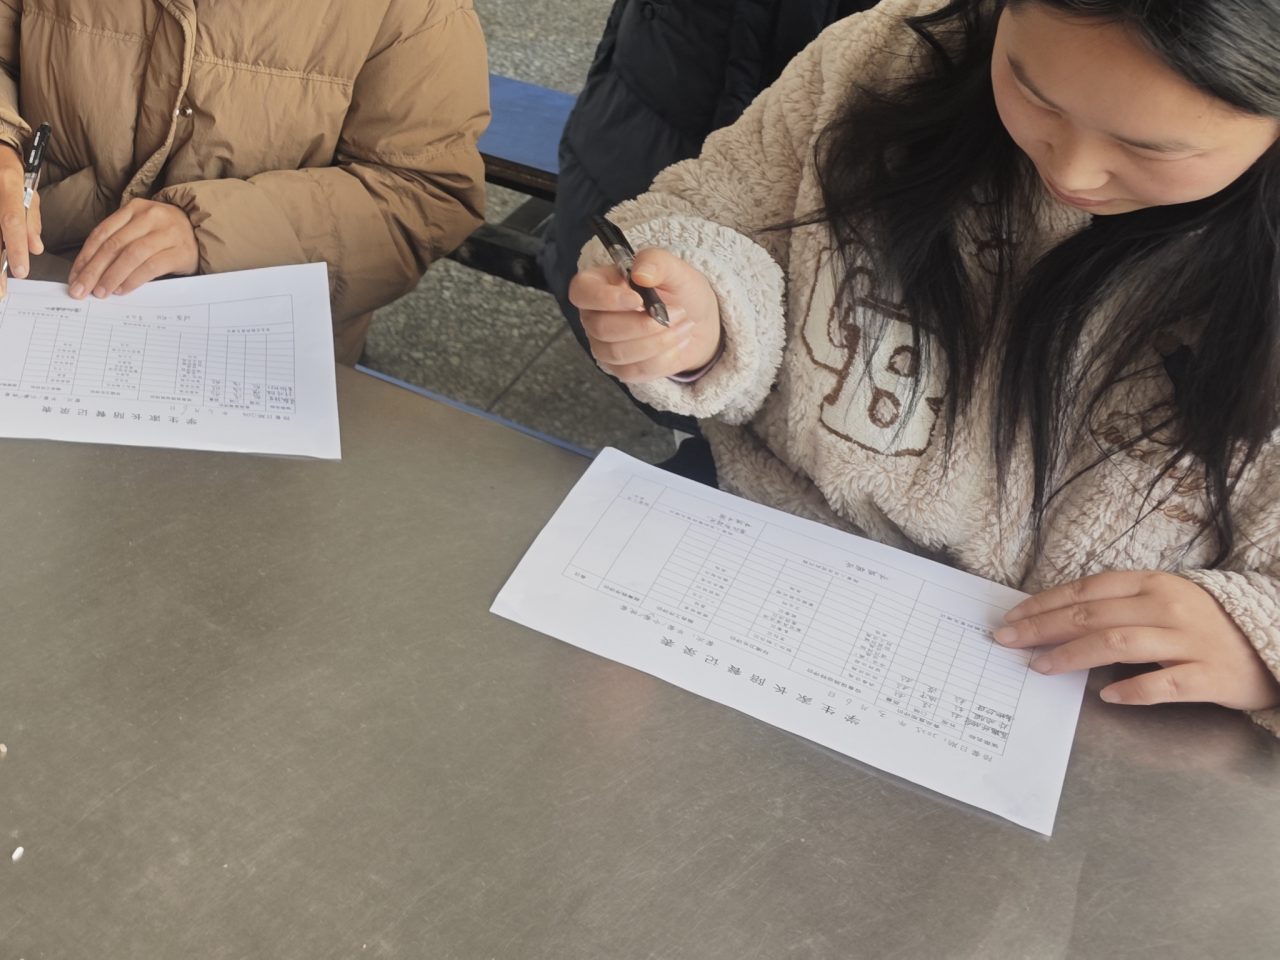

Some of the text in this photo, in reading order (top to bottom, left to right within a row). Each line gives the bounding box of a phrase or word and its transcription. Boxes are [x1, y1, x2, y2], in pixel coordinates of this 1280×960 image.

[659, 635, 862, 728] 学生家长陪餐记录表
